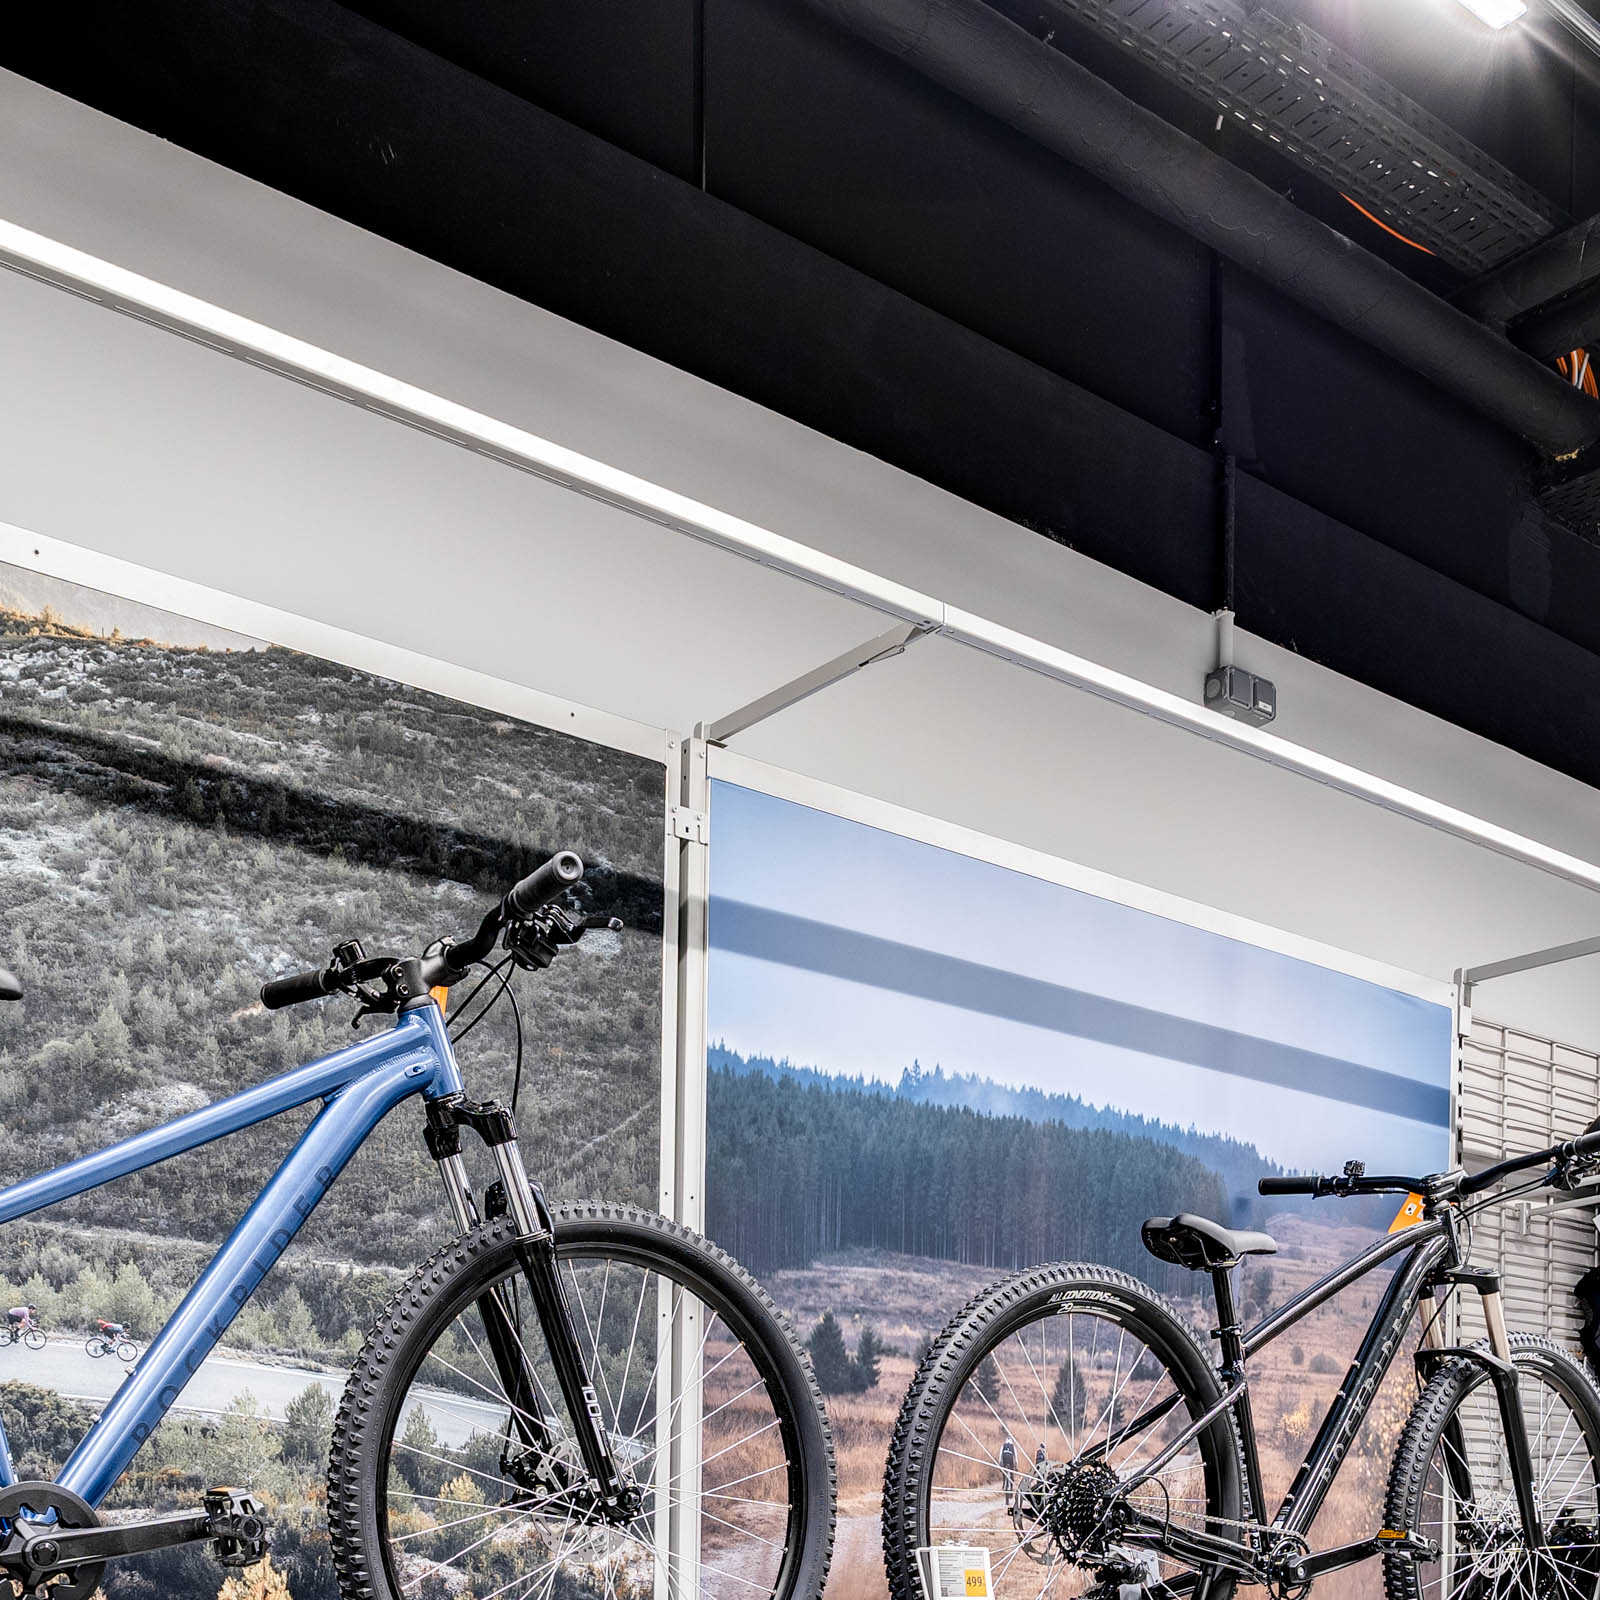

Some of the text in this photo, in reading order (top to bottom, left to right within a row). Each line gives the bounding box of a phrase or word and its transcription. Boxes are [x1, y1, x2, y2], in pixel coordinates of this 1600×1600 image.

[1048, 1289, 1113, 1304] ALL CONDITIONS
[1057, 1302, 1074, 1315] 29
[1252, 1538, 1259, 1548] 3
[967, 1575, 983, 1588] 499
